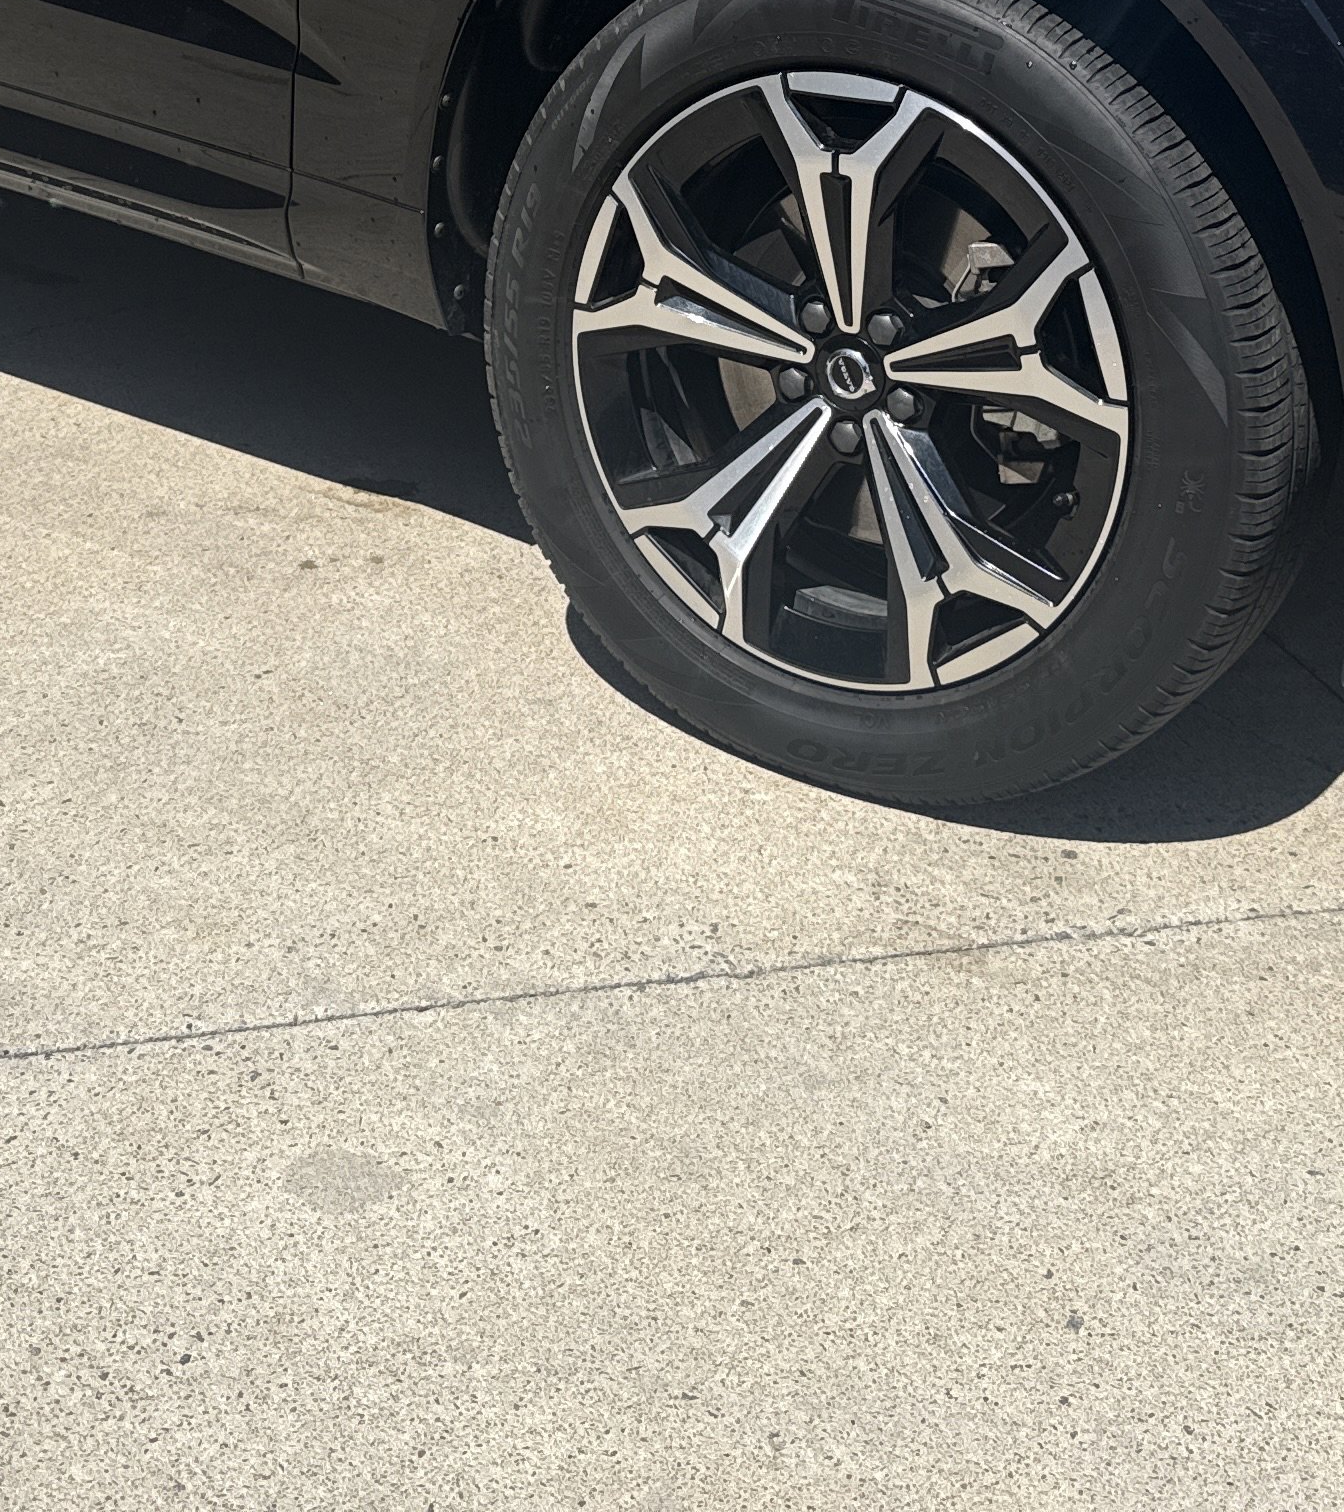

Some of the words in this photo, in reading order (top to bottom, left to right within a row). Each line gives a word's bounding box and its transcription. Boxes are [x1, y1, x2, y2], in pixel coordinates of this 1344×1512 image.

[511, 182, 541, 269] R19
[504, 271, 533, 450] 235/55
[973, 535, 1190, 770] SCORPION
[785, 736, 947, 777] ZERO
